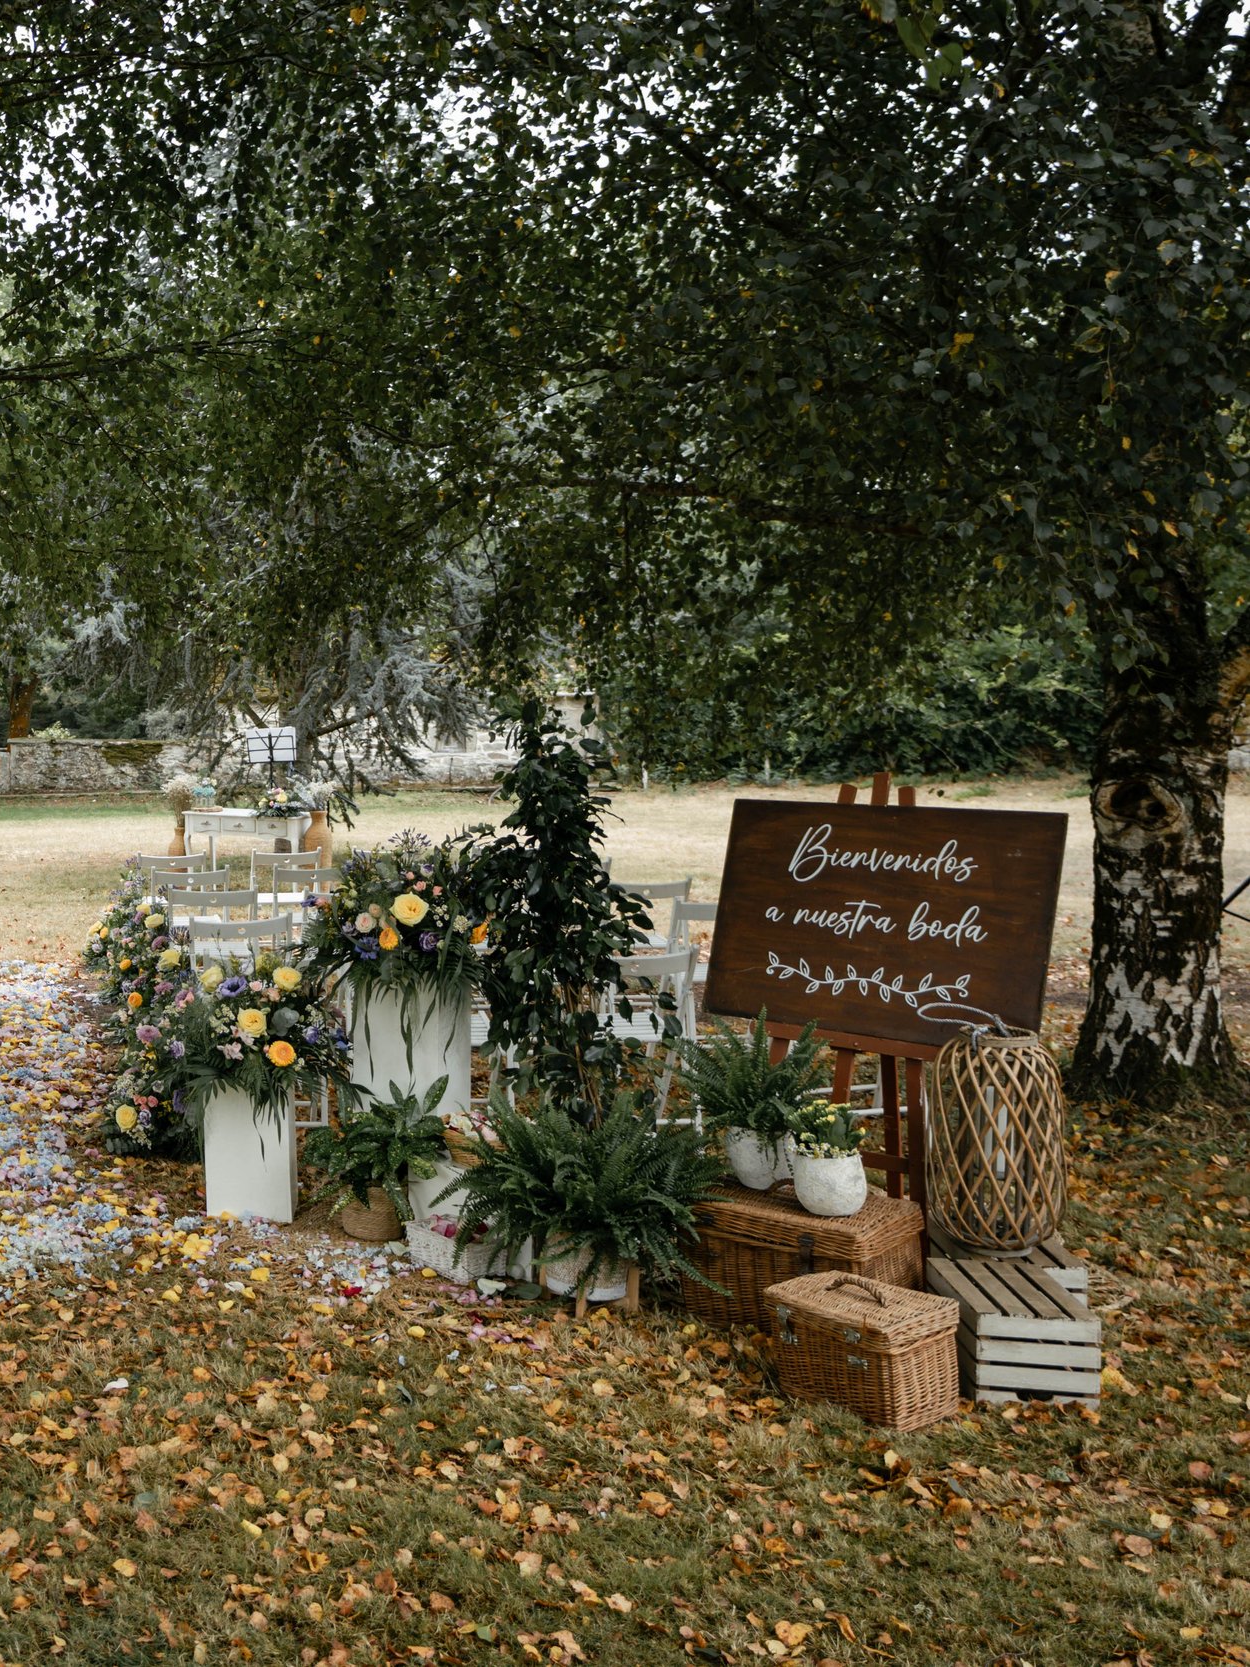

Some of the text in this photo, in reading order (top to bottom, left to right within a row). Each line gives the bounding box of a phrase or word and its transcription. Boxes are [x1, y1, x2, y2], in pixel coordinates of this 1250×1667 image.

[788, 823, 978, 882] Bienvenidos
[765, 900, 988, 947] a nuestra boda
